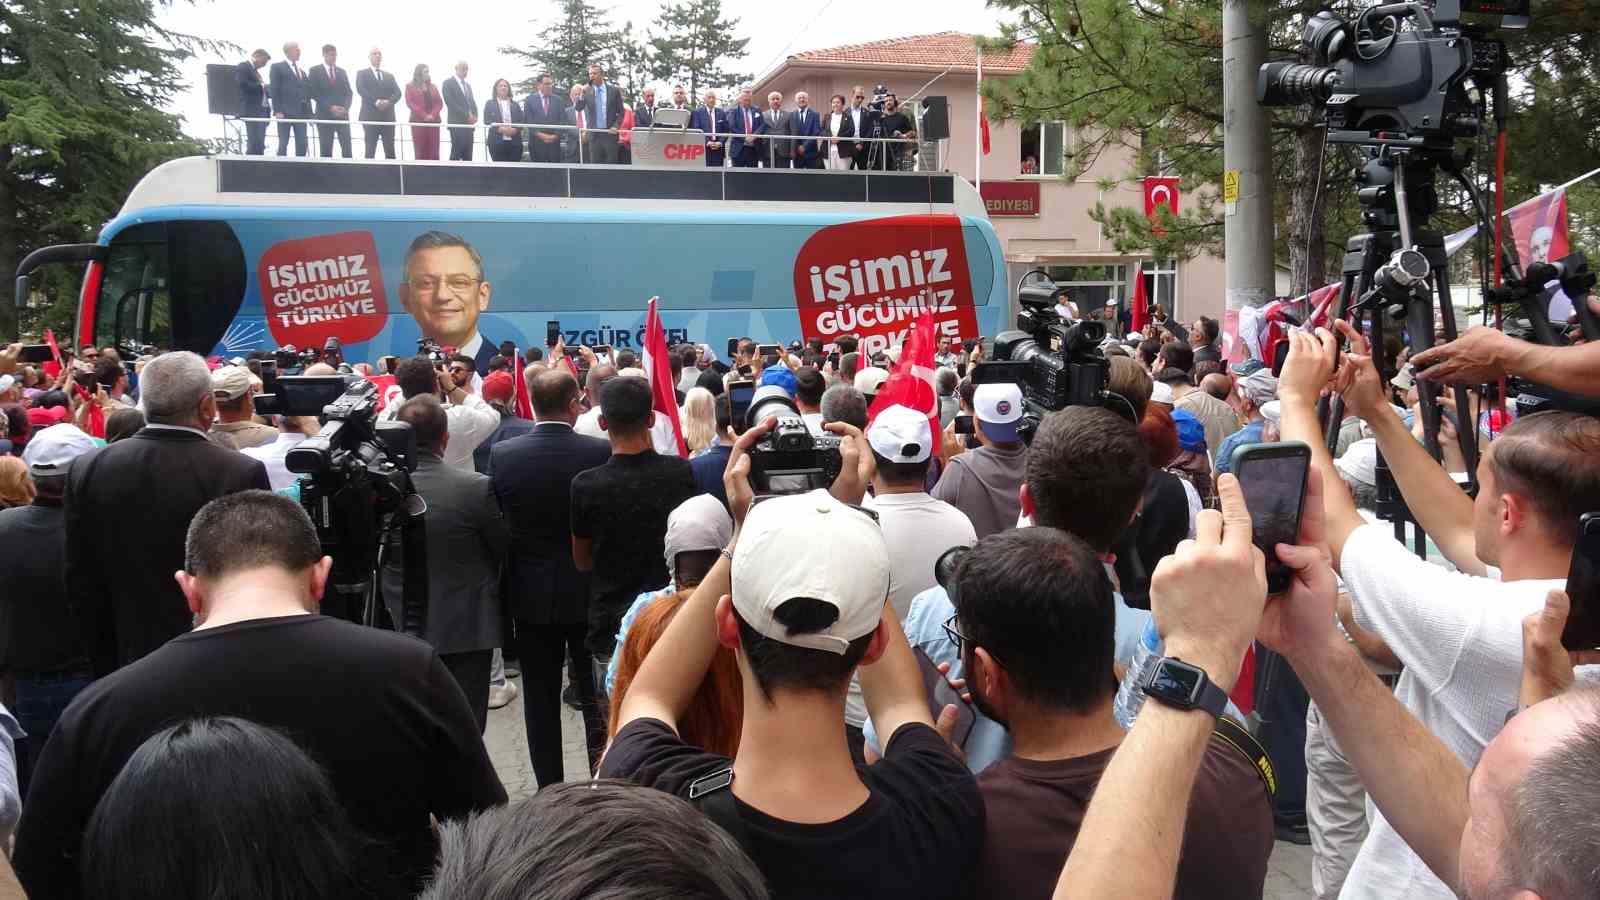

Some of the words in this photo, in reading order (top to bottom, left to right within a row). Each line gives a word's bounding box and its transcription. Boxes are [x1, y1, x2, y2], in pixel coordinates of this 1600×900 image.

[662, 143, 705, 160] CHP
[274, 279, 372, 307] GÜCÜMÜZ
[276, 298, 376, 328] TÜRKİYE
[816, 287, 957, 335] GÜCÜMÜZ
[635, 324, 695, 347] ÖEL
